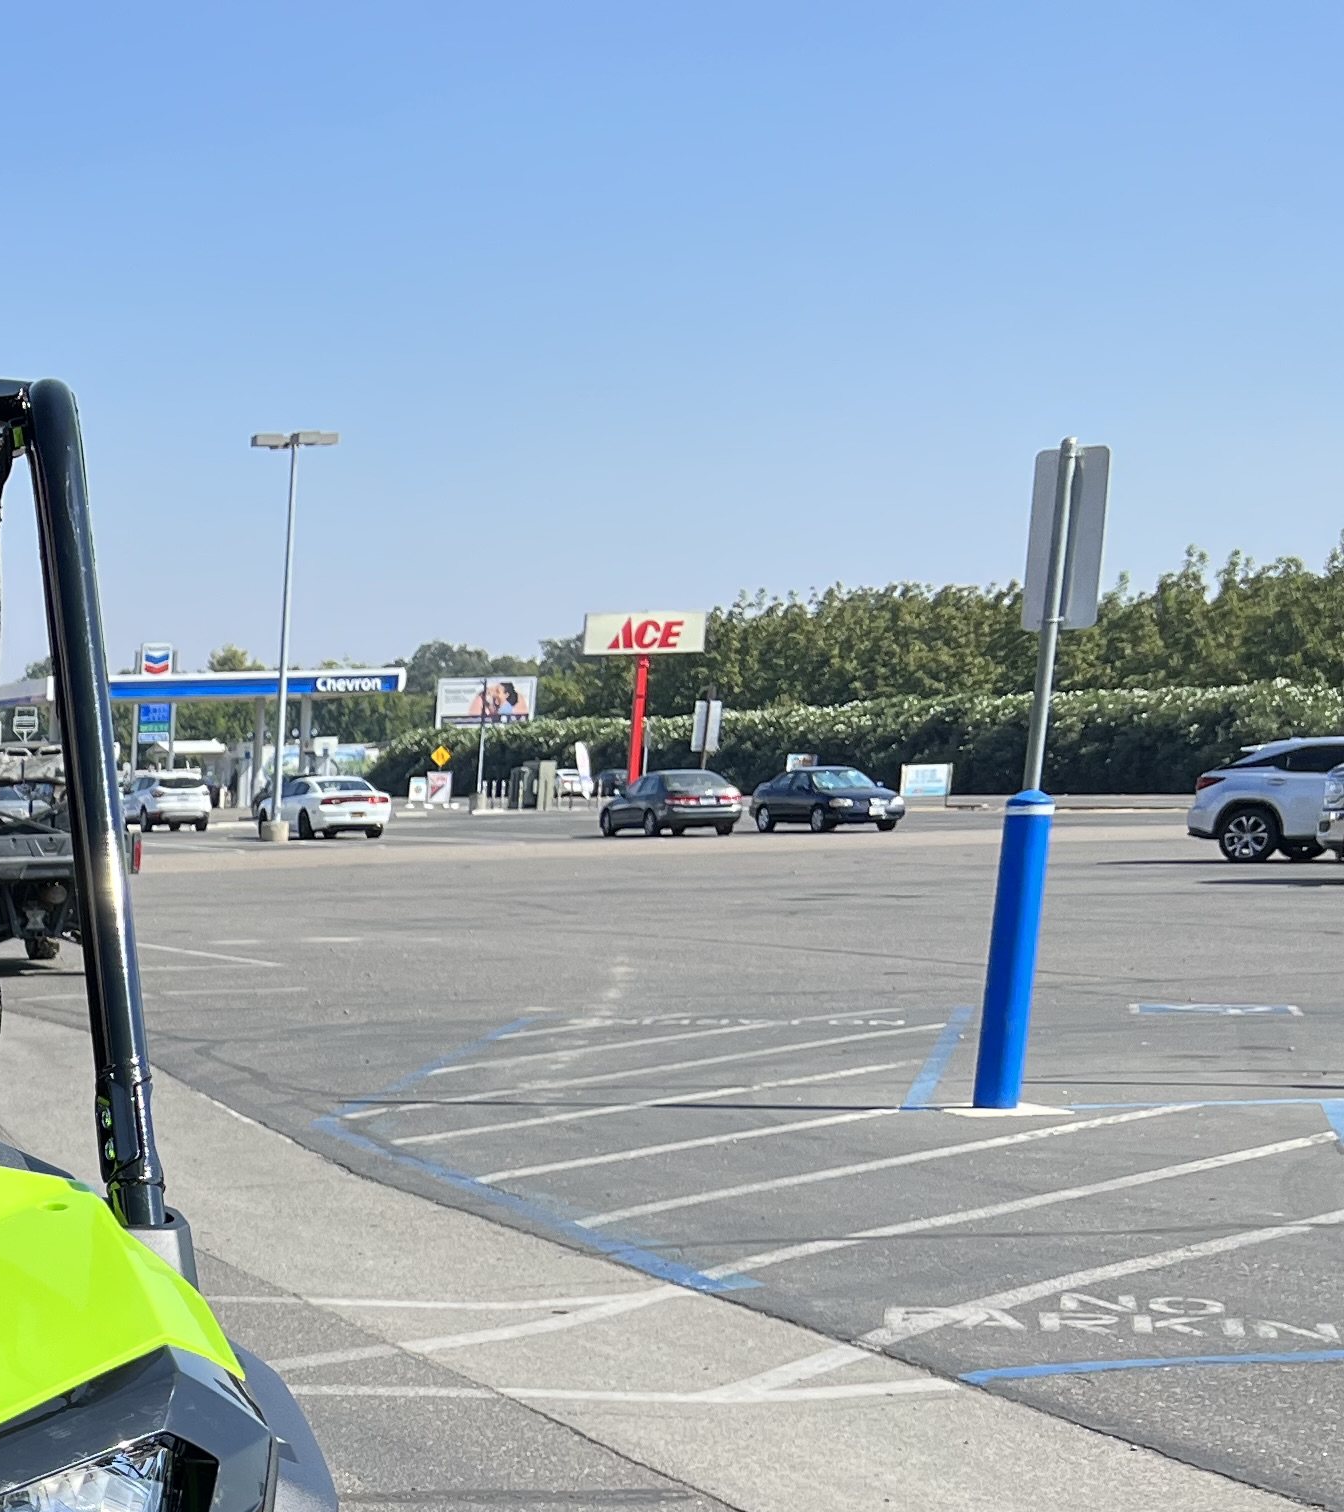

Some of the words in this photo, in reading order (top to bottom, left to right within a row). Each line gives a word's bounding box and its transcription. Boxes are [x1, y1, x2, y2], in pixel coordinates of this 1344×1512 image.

[607, 616, 684, 649] ACE
[315, 677, 381, 692] Chevron
[1059, 1291, 1226, 1315] NO
